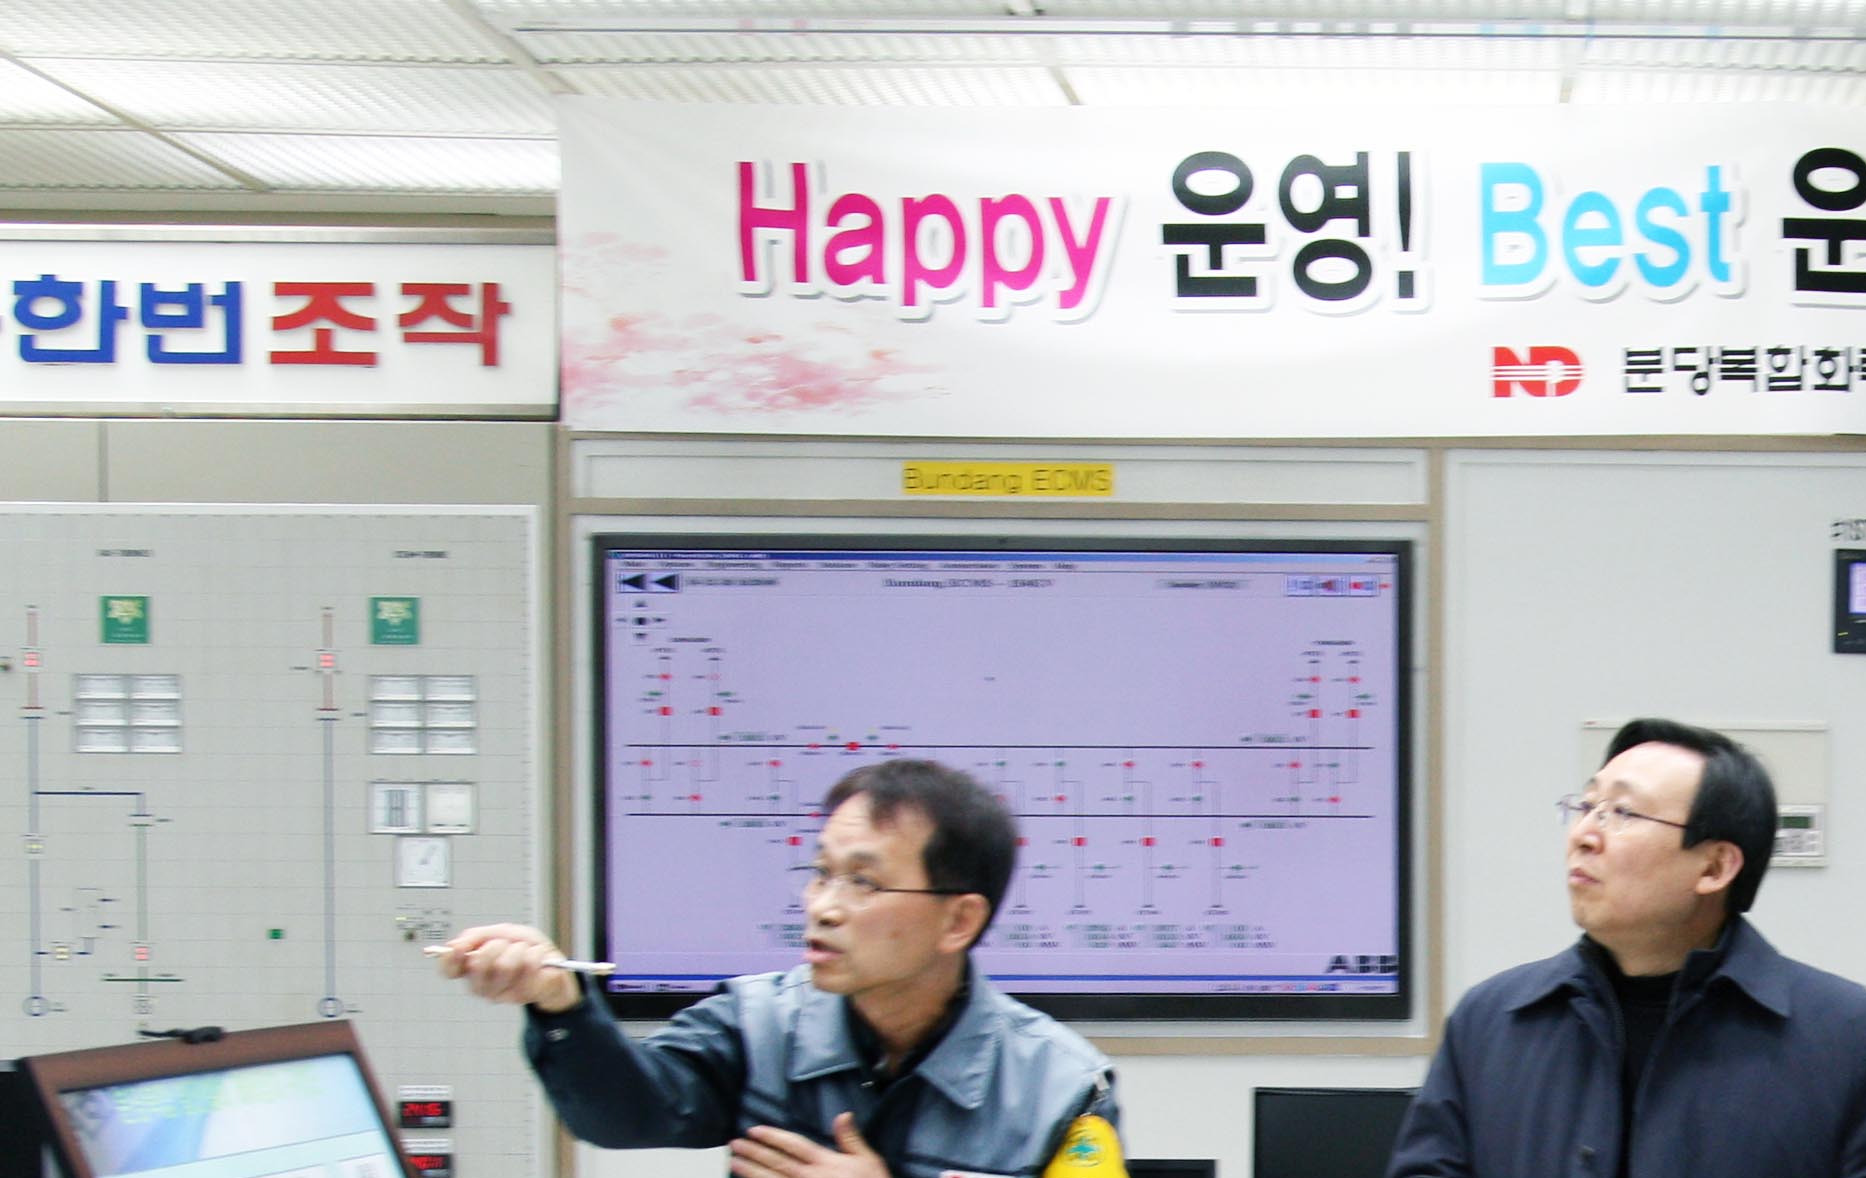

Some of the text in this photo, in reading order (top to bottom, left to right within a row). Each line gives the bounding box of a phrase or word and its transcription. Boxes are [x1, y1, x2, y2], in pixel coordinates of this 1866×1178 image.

[736, 161, 1112, 309] Happy
[1161, 150, 1415, 301] 운영!
[1480, 162, 1732, 288] Best
[0, 274, 510, 366] 한번 조작
